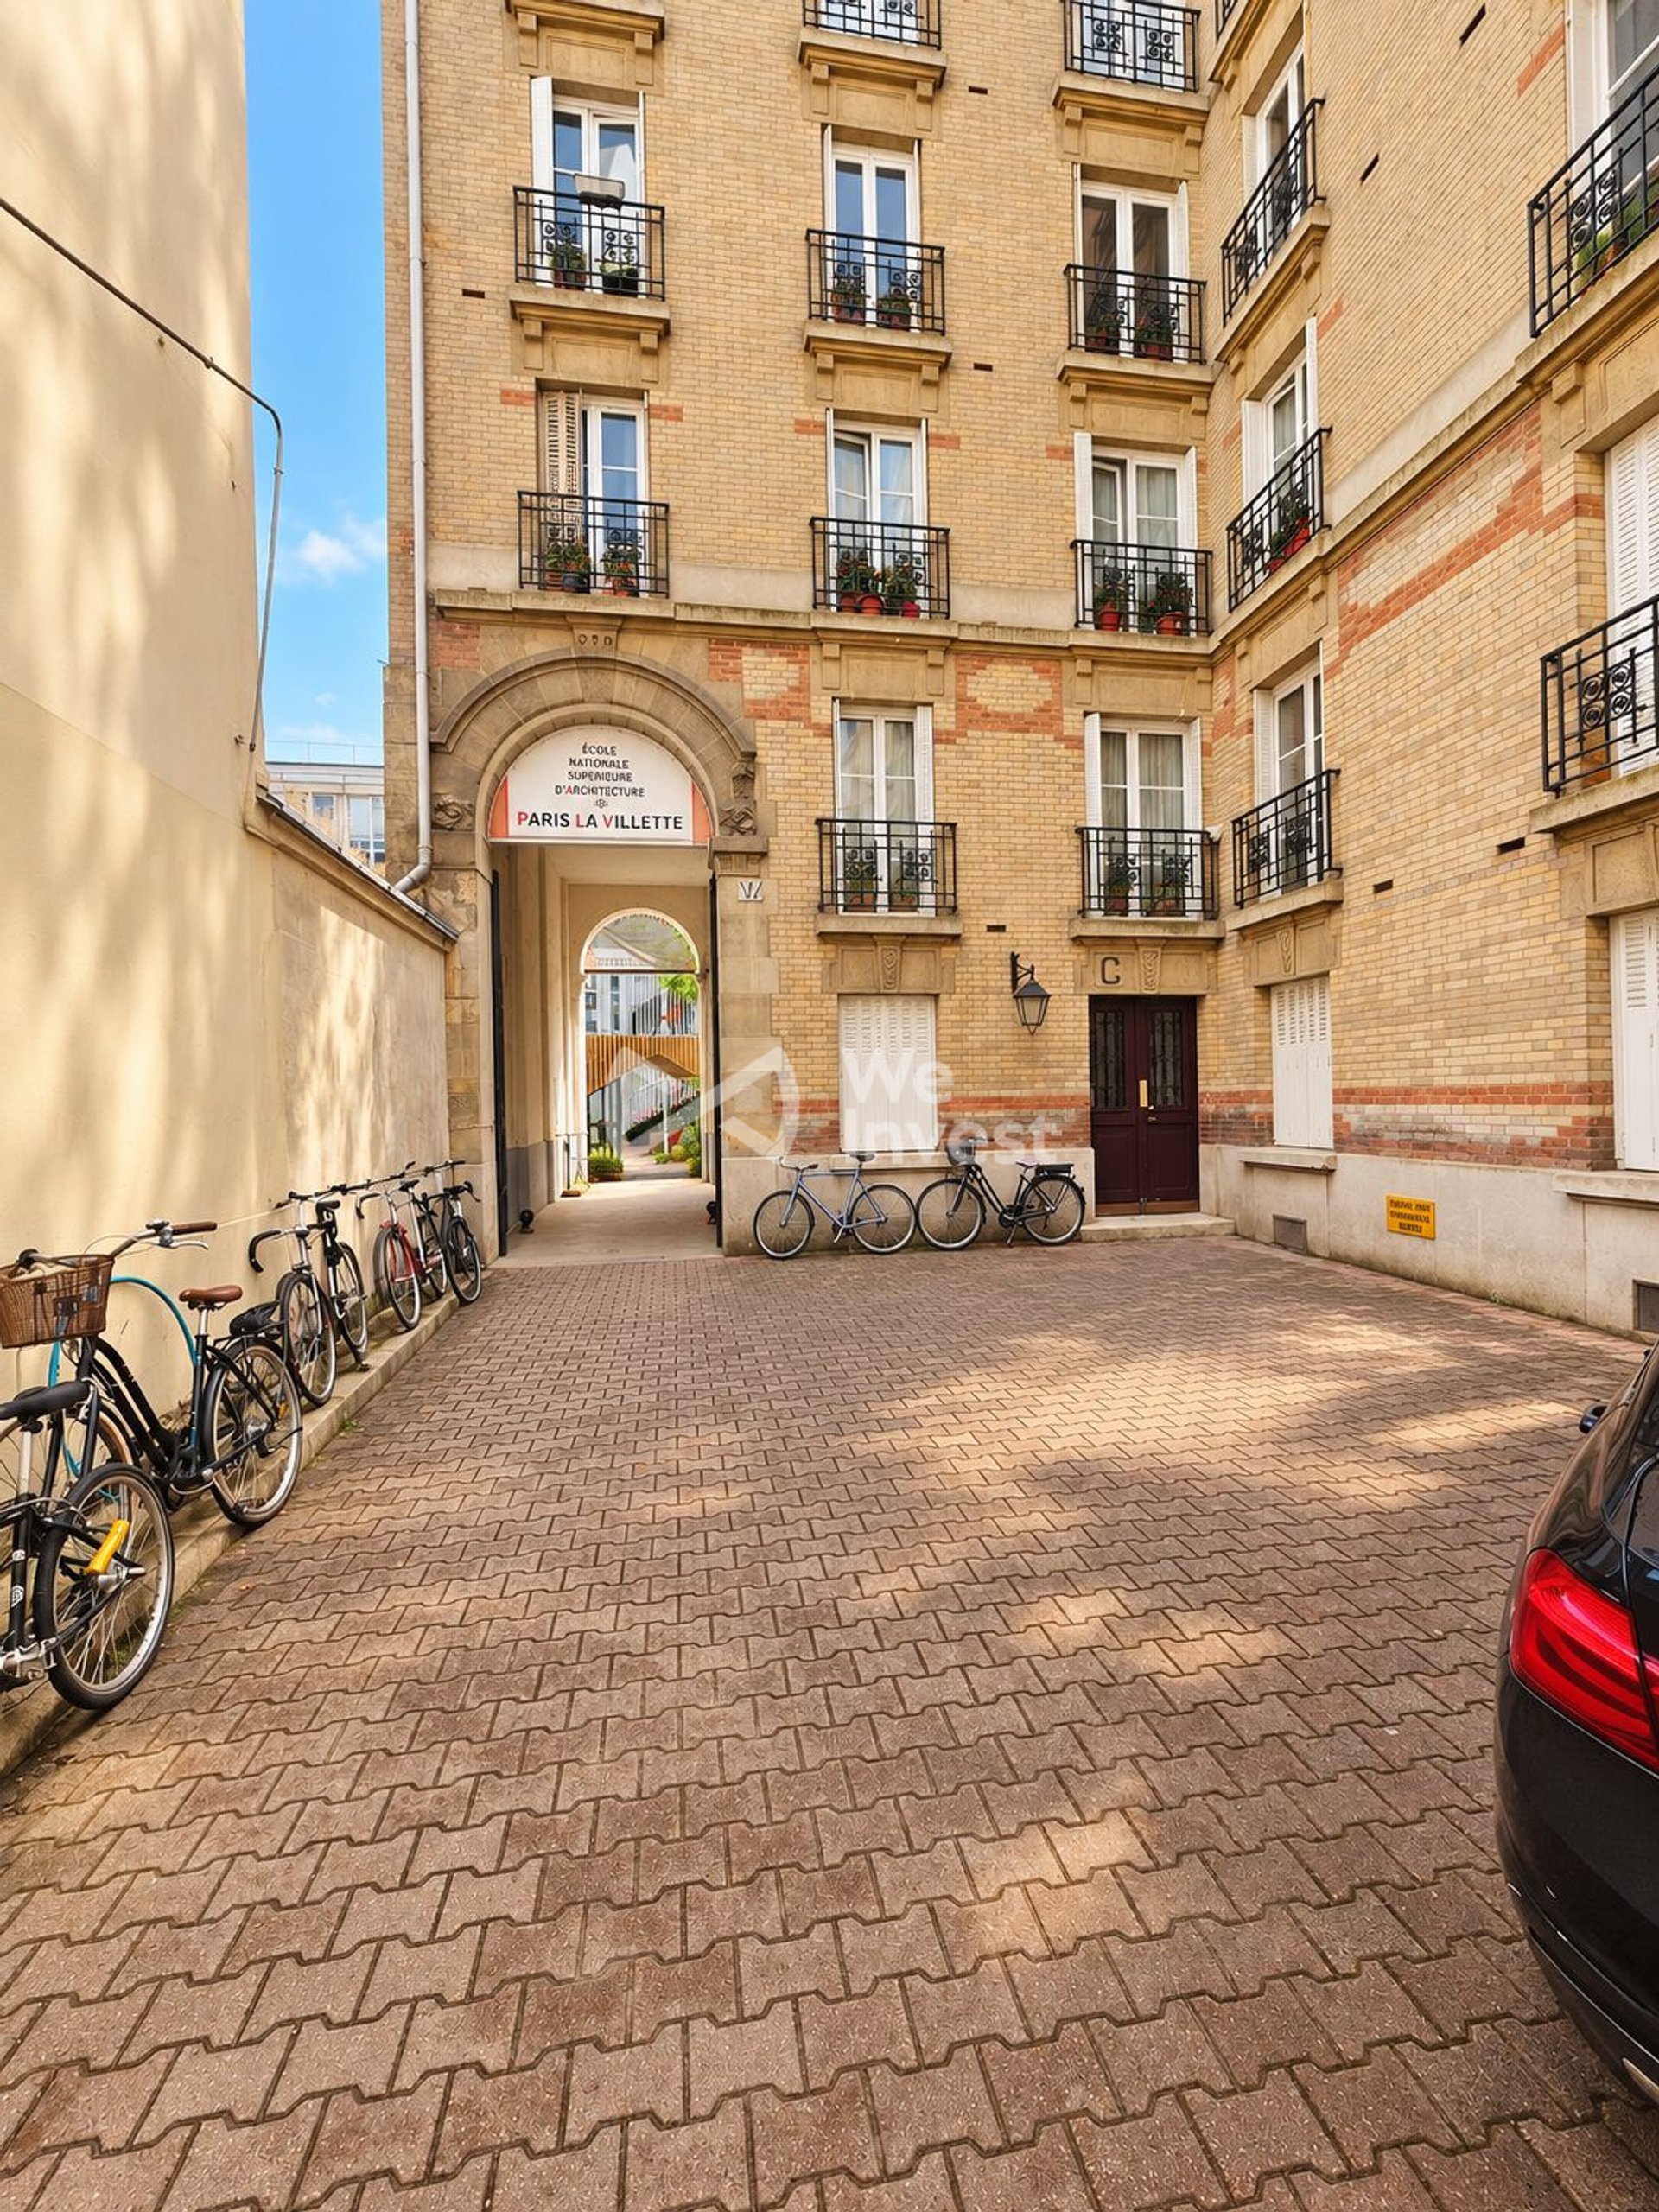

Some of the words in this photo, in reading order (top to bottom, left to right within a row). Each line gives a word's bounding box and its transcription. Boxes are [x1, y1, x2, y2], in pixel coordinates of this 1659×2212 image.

[582, 742, 617, 756] ÉCOLE
[569, 758, 629, 769] NATIONALE
[555, 785, 645, 797] D'ARCHITECTURE
[518, 811, 570, 828] PARIS
[576, 813, 598, 829] LA
[602, 814, 683, 830] VILLETTE
[1101, 956, 1121, 984] C
